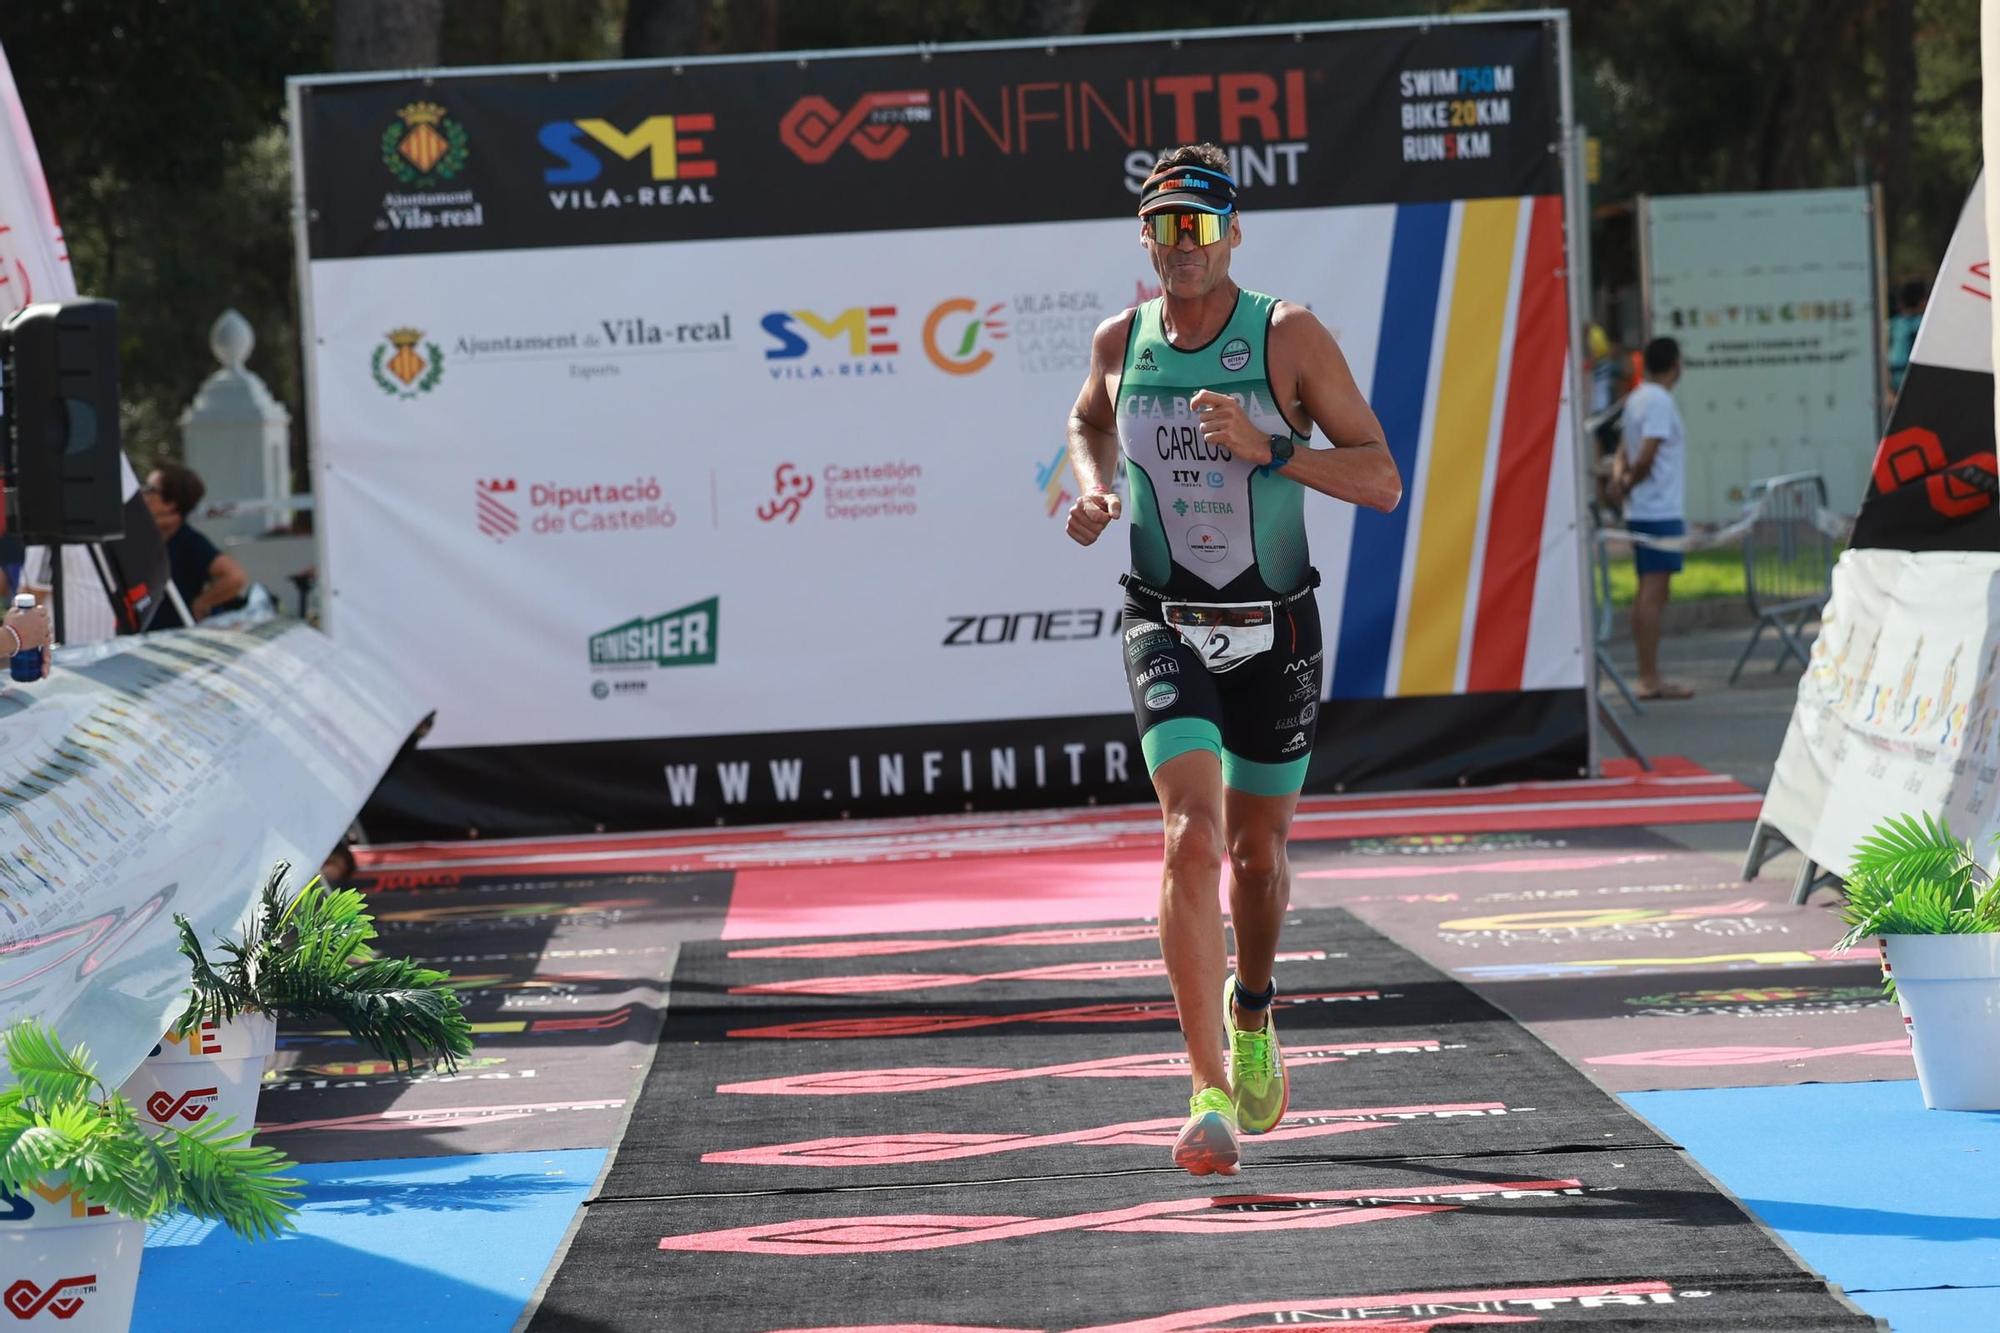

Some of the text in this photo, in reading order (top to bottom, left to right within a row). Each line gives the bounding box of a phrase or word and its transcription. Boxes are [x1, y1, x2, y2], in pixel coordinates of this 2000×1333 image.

[938, 69, 1308, 158] INFINITRI
[1401, 102, 1449, 129] BIKE
[537, 114, 716, 184] SME
[1123, 144, 1308, 194] SINT
[549, 185, 713, 210] VILA-REAL
[387, 203, 483, 229] Vila-real
[455, 334, 577, 358] Ajuntament
[602, 313, 732, 347] Vila-real
[760, 306, 898, 359] SME
[769, 362, 898, 379] VILA-REAL
[1172, 470, 1200, 482] ITV
[530, 476, 661, 510] Diputació
[1193, 499, 1234, 514] BÉTERA
[532, 503, 677, 533] de Castelló
[592, 611, 709, 660] FINISHER
[1208, 633, 1231, 660] 2
[1135, 662, 1176, 686] SOLARTE
[664, 741, 1128, 807] WWW.INFINITR
[1274, 1294, 1676, 1324] INFINITRI
